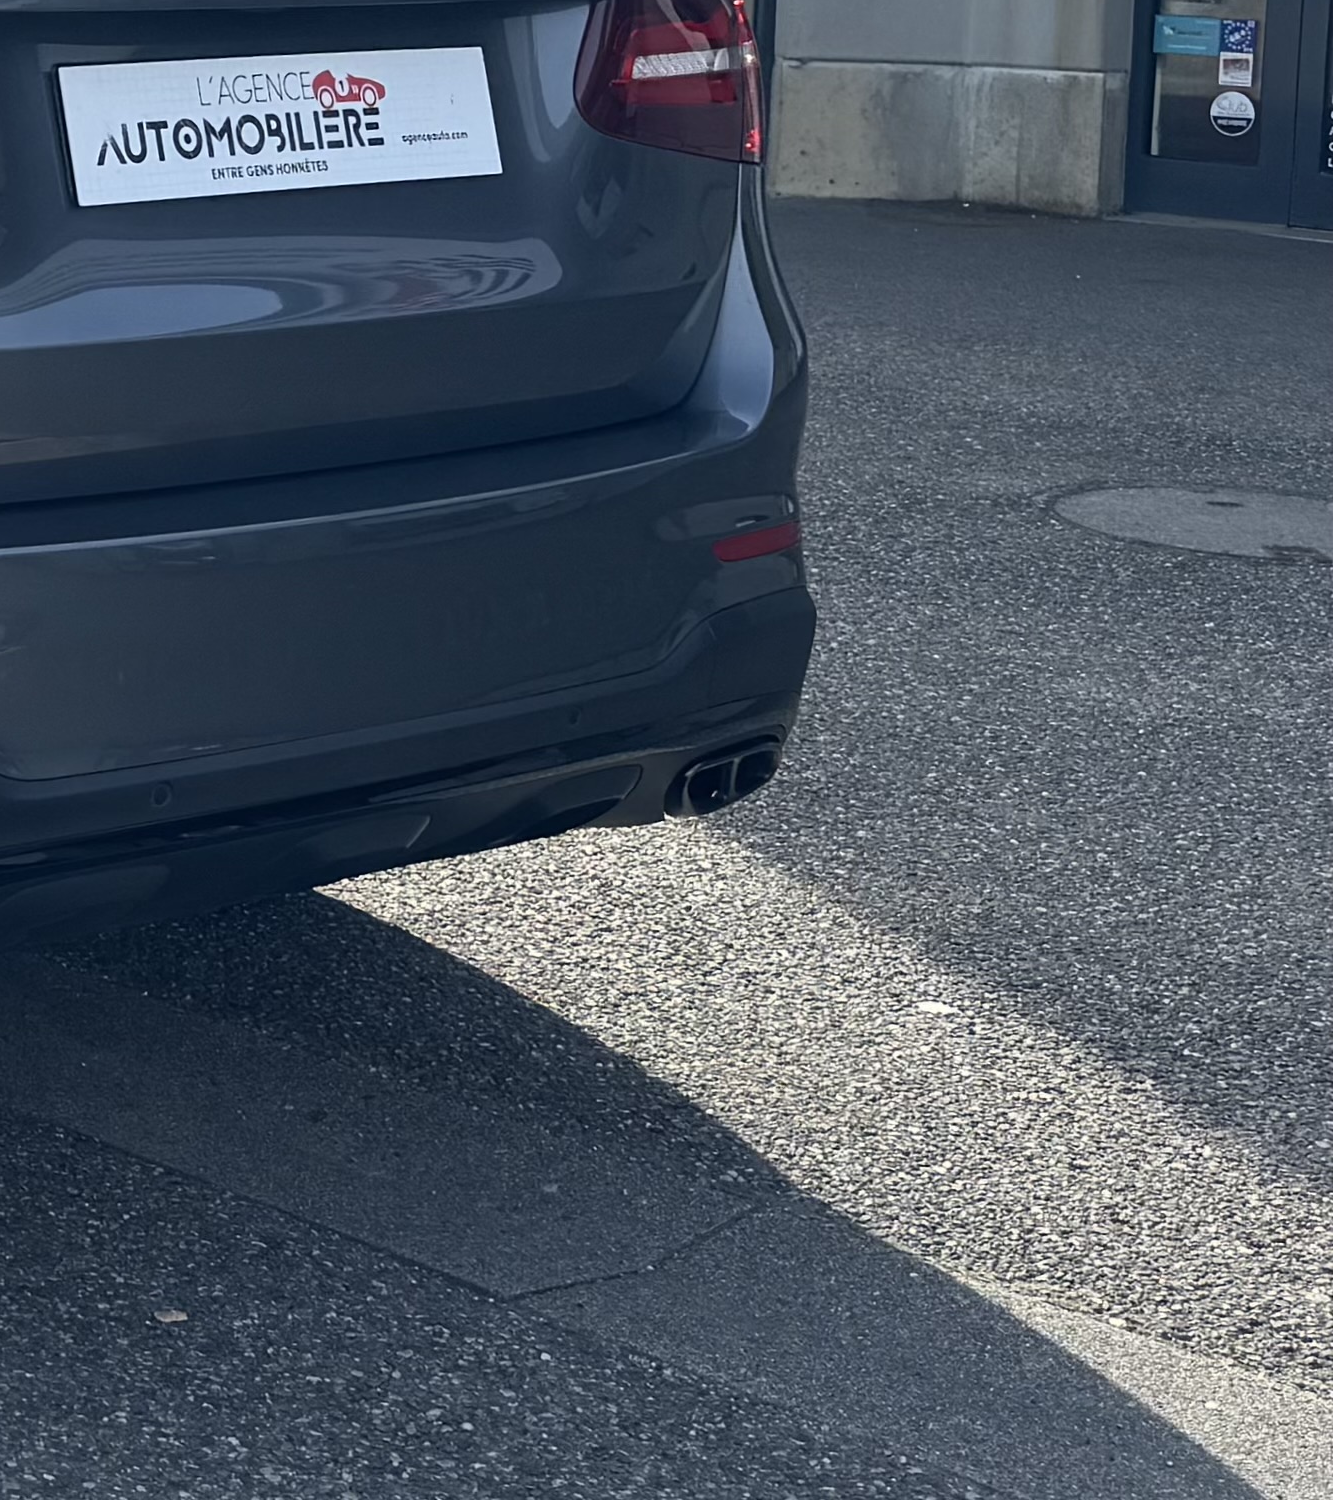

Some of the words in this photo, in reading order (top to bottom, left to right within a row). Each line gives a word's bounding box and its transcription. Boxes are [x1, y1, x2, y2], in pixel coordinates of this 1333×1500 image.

[197, 71, 315, 107] L'AGENCE
[96, 106, 386, 167] AUTOMOBILIERE
[211, 166, 244, 180] ENTRE
[246, 164, 275, 177] GENS
